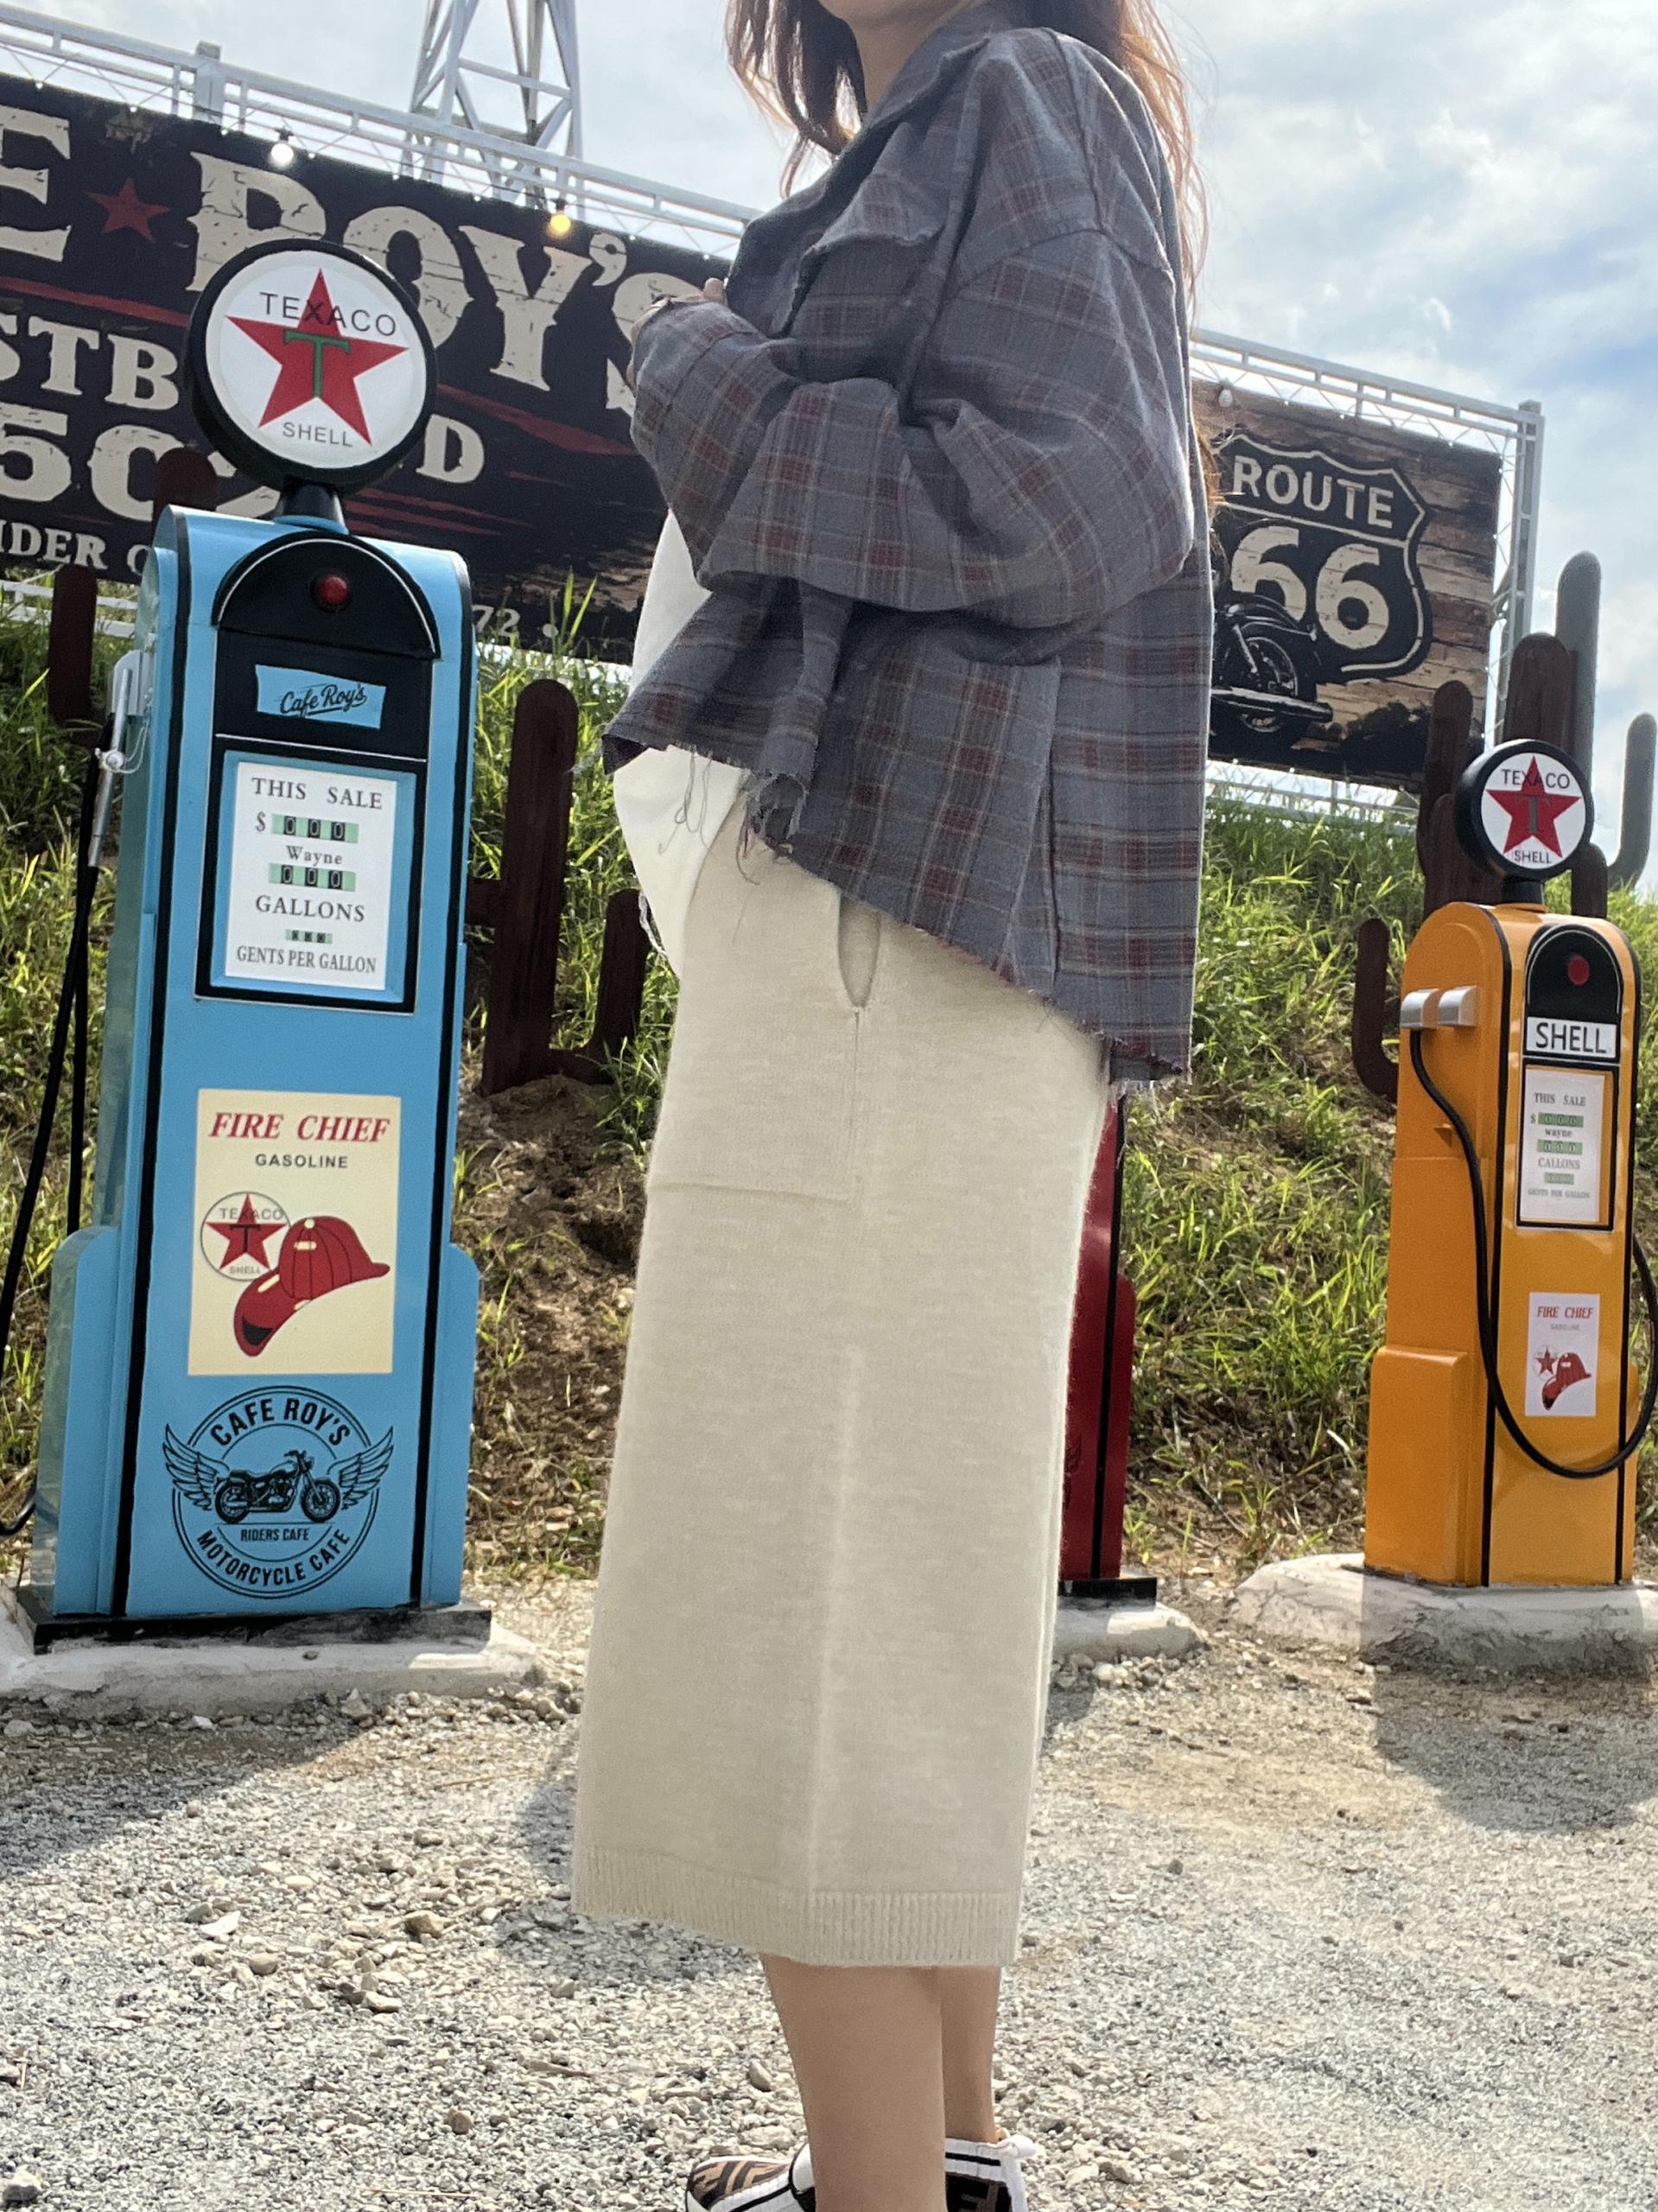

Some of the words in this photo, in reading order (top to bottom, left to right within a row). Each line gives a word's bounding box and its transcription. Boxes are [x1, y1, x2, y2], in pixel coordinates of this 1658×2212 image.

[260, 292, 397, 337] TEXACO
[283, 422, 353, 448] SHELL
[1233, 455, 1394, 529] ROUTE
[1230, 525, 1389, 651] 66
[280, 689, 319, 717] Cafe
[321, 683, 368, 712] Roy's
[251, 777, 307, 800] THIS
[327, 786, 383, 810] SALE
[255, 810, 267, 832] $
[285, 844, 343, 867] Wayne
[1514, 849, 1552, 864] SHELL
[256, 895, 365, 923] GALLONS
[288, 950, 315, 969] PER
[319, 953, 377, 973] GALLON
[1535, 1021, 1607, 1054] SHELL
[1534, 1092, 1556, 1103] THIS
[1563, 1094, 1586, 1107] SALE
[208, 1112, 284, 1140] FIRE
[296, 1115, 391, 1143] CHIEF
[255, 1154, 348, 1169] GASOLINE
[1536, 1306, 1559, 1319] FIRE
[1564, 1306, 1594, 1319] CHIEF
[210, 1398, 275, 1446] CAFE
[283, 1397, 351, 1446] ROY'S
[240, 1528, 280, 1541] RIDERS
[283, 1528, 310, 1541] CAFE
[196, 1529, 307, 1586] MOTORCYCLE
[309, 1529, 351, 1572] CAFE
